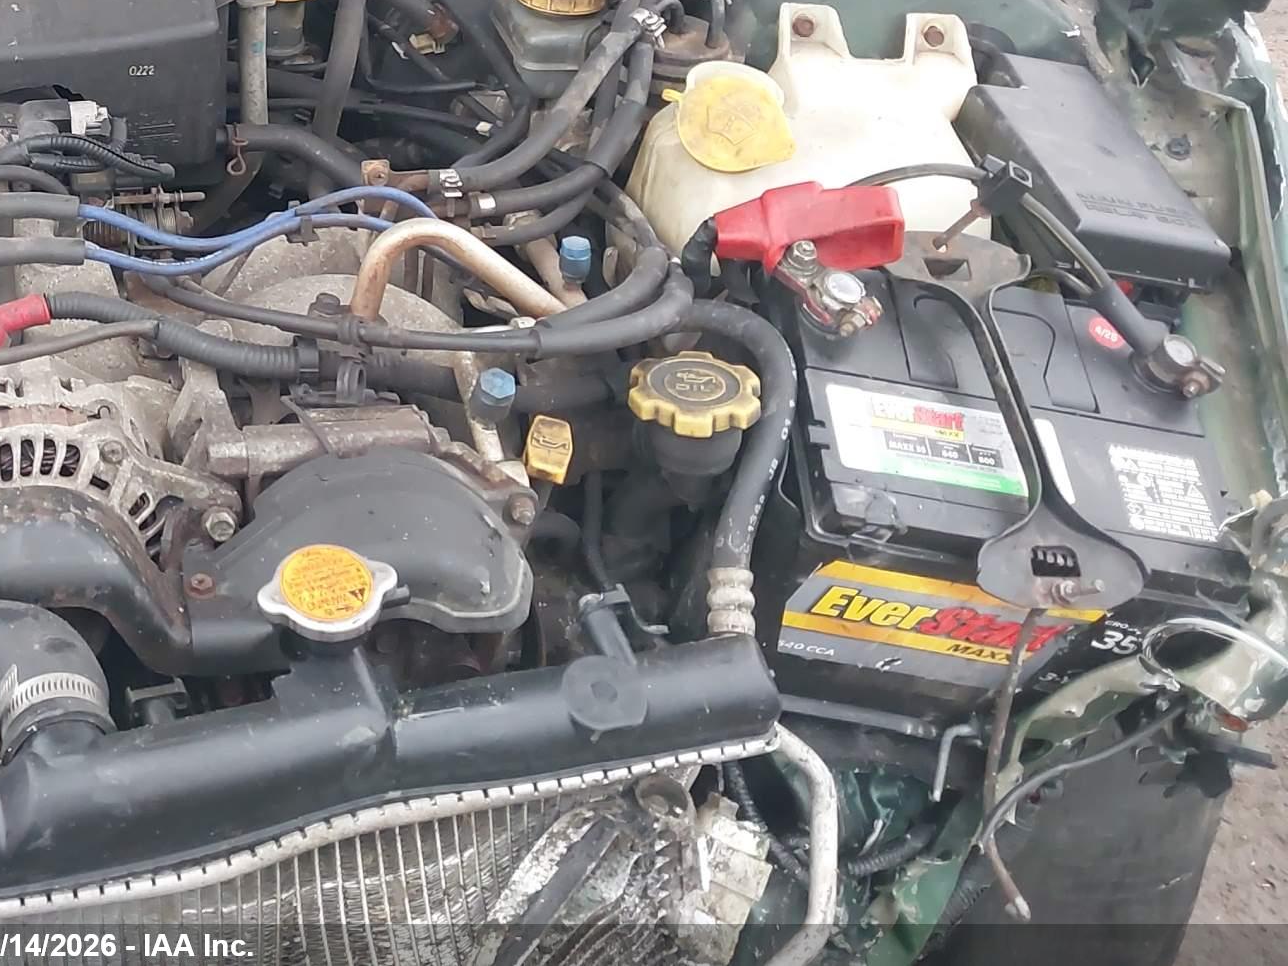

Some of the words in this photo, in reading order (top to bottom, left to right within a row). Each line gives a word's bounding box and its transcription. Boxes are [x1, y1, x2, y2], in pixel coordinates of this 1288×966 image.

[675, 383, 711, 393] OIL
[809, 585, 1070, 652] EverStat
[806, 645, 835, 656] CCA
